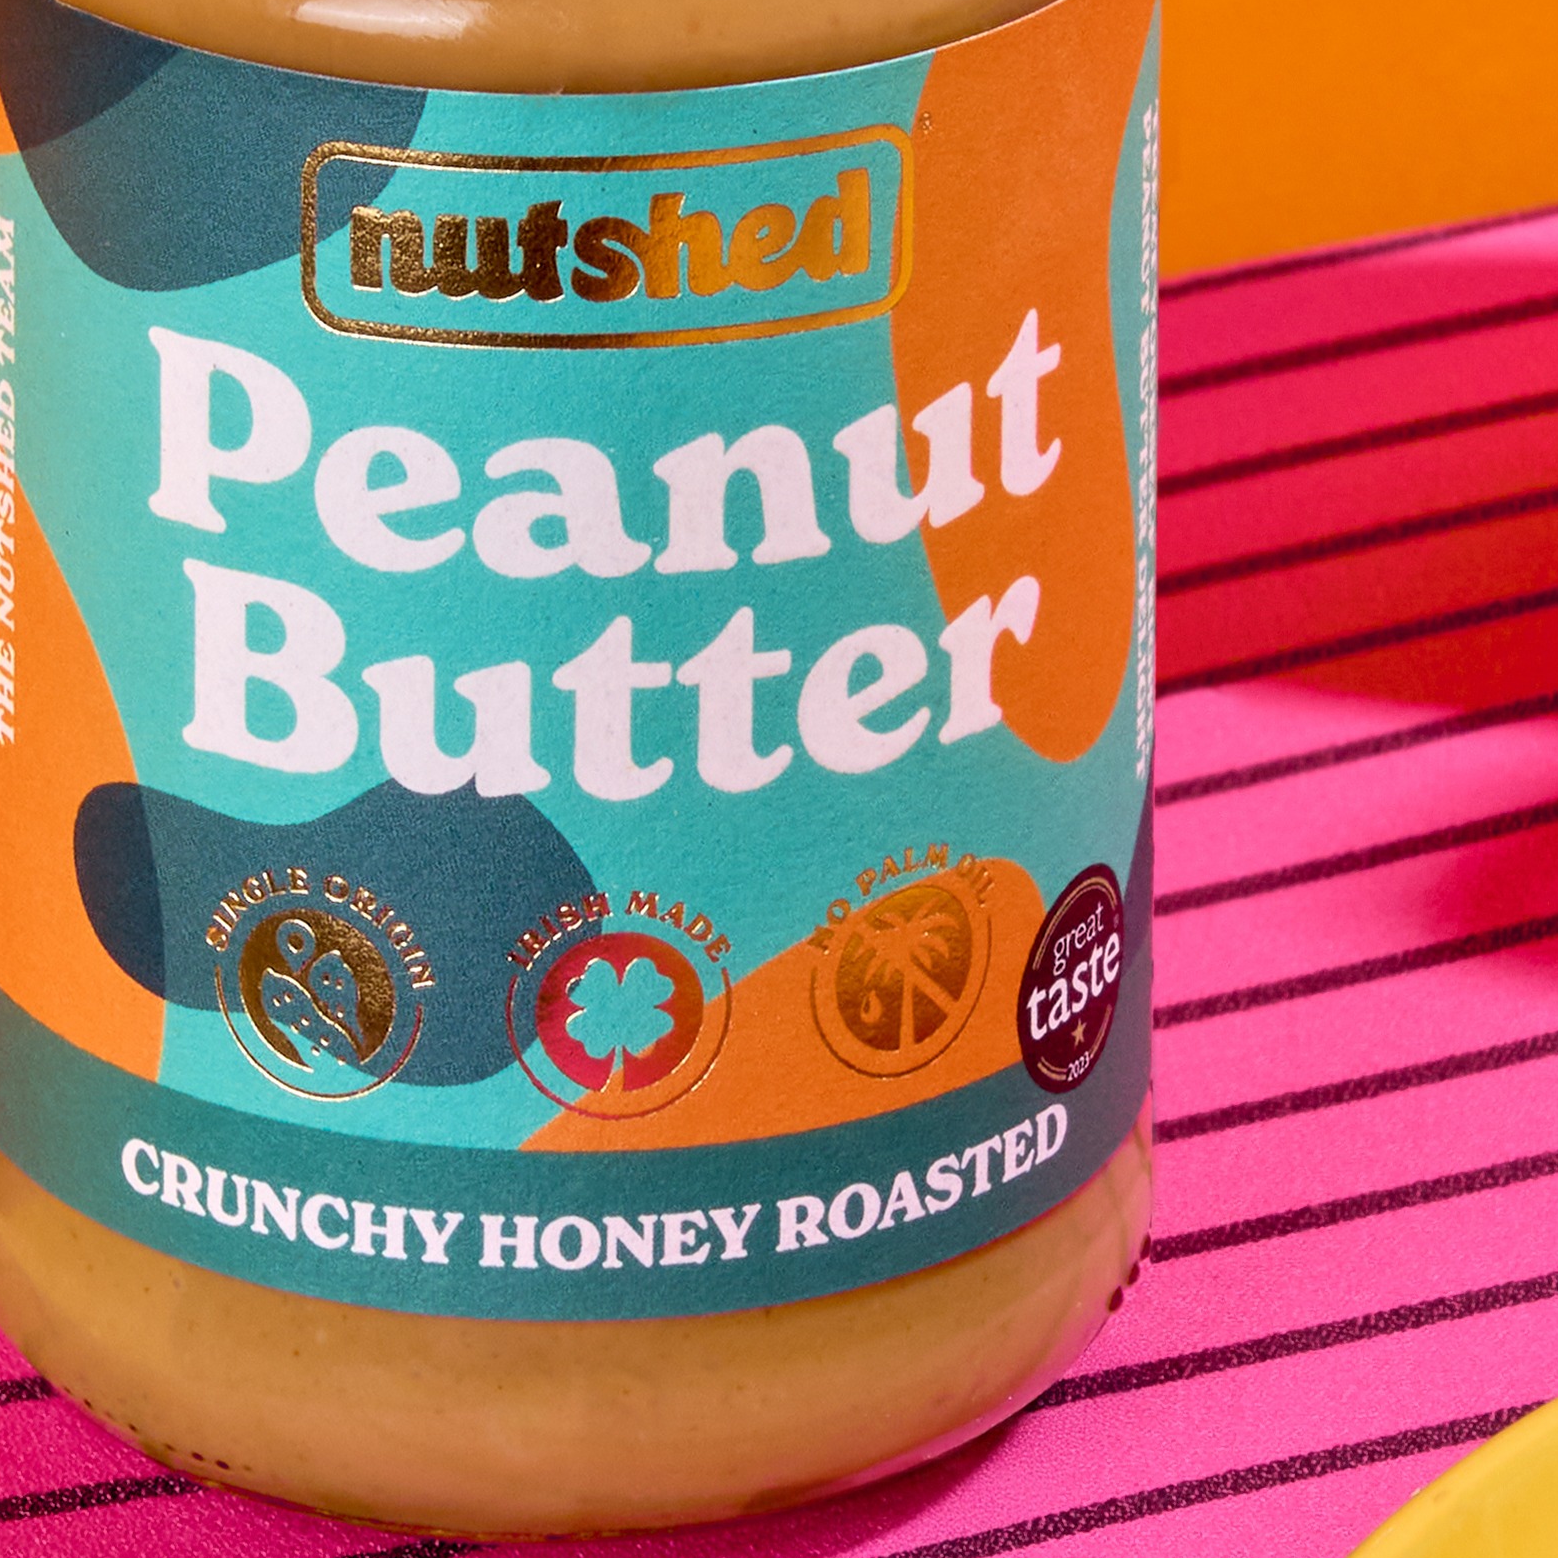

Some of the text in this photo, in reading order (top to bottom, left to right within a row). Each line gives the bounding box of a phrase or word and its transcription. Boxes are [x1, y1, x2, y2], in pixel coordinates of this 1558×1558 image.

[350, 166, 871, 303] nutshed
[147, 308, 1062, 578] Peanut
[181, 558, 1041, 800] Butter
[205, 866, 436, 990] SINGLE ORIGIN
[855, 842, 950, 897] PALM
[506, 890, 732, 971] IRISH MADE
[1026, 931, 1120, 1041] taste
[1052, 901, 1105, 976] great
[1066, 1051, 1091, 1082] 2023
[121, 1103, 1070, 1270] CRUNCHY HONEY ROASTED
